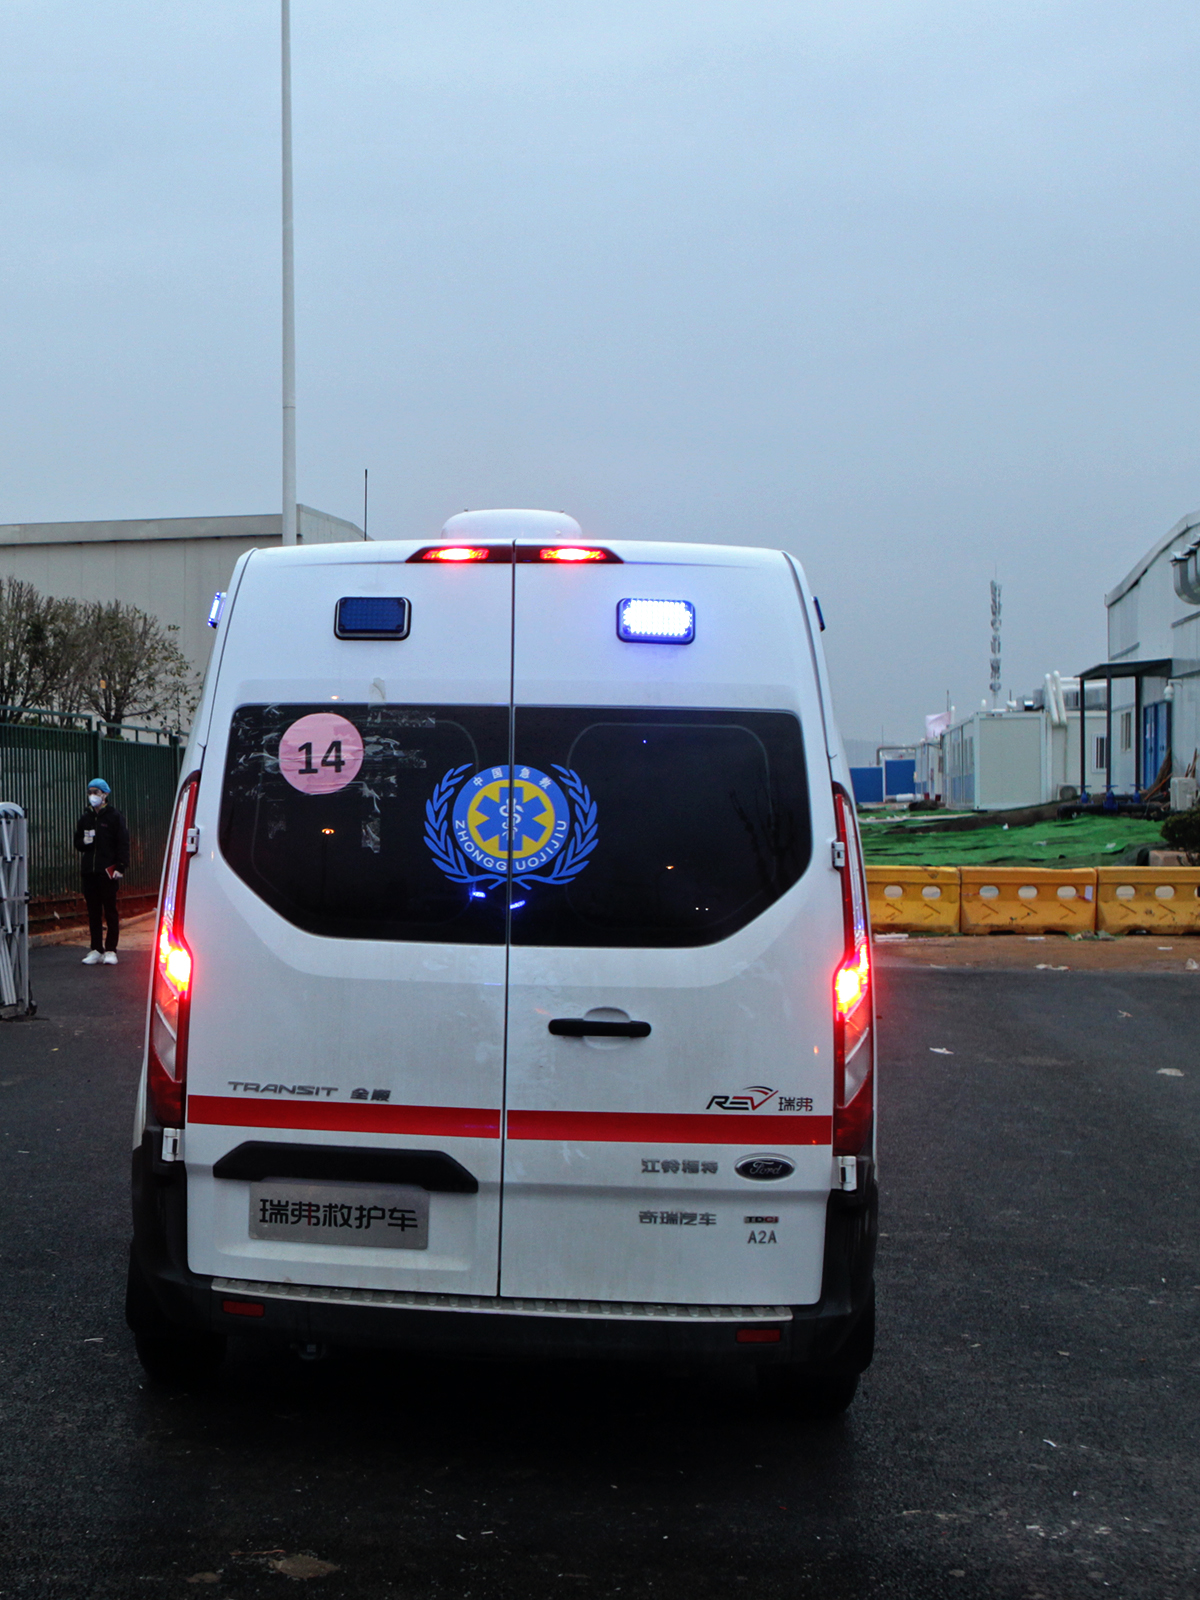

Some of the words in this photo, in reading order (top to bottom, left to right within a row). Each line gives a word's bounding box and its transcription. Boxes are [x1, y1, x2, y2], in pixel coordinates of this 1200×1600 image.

[298, 740, 346, 775] 14
[472, 766, 552, 790] 中国急救
[227, 1081, 339, 1097] TRANSIT
[705, 1089, 779, 1111] REV
[778, 1096, 814, 1112] 瑞弗
[640, 1157, 719, 1175] 江铃福特
[749, 1159, 782, 1176] Ford
[258, 1198, 419, 1232] 瑞弗救护车
[638, 1210, 718, 1227] 奇瑞汽车
[747, 1229, 778, 1245] A2A
